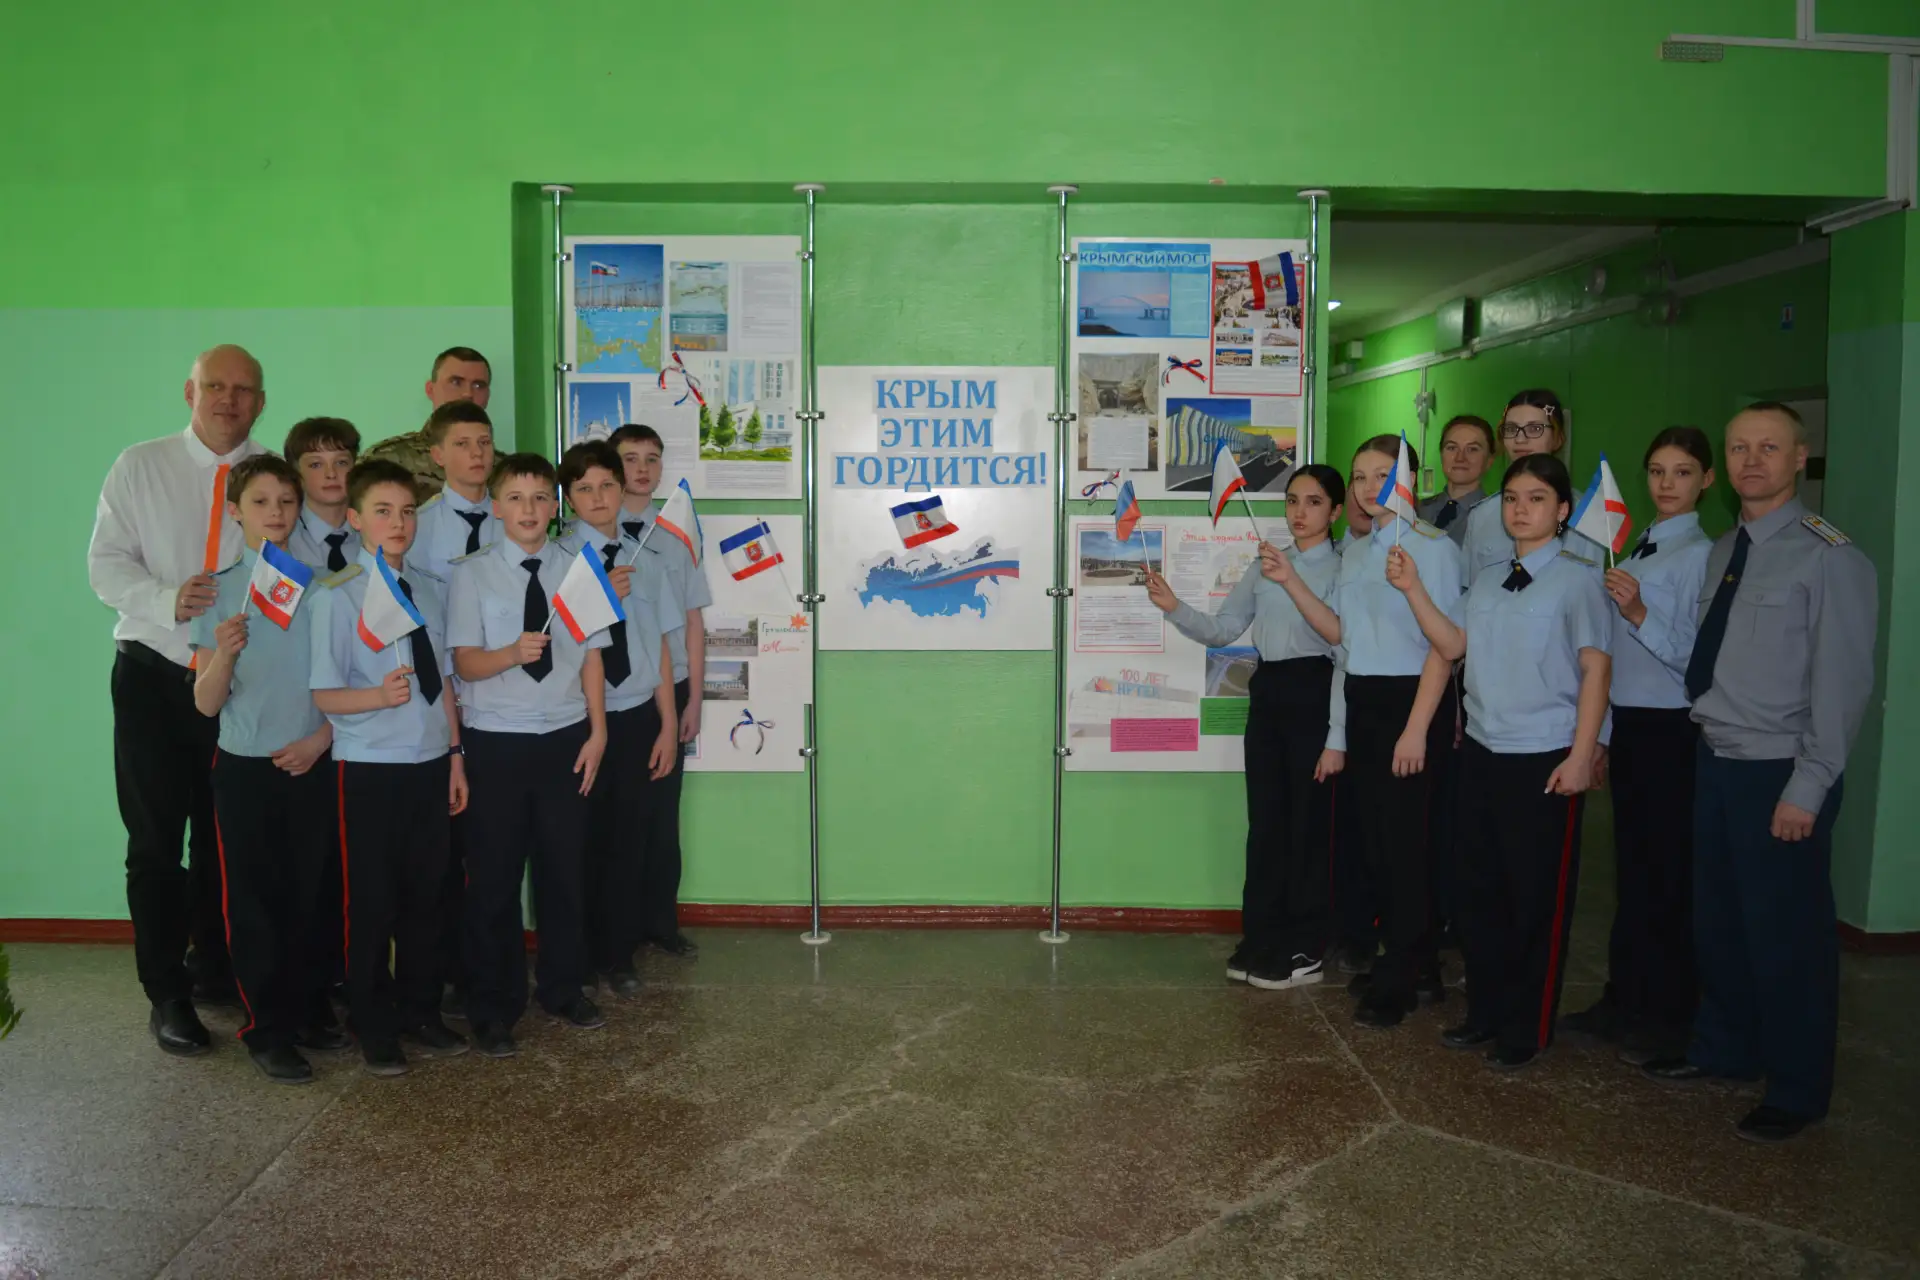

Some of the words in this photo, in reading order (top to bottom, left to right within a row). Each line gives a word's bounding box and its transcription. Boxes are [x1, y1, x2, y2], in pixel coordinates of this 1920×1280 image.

[1079, 252, 1166, 265] КРЫМСКИЙ
[1167, 253, 1208, 264] МОСТ
[876, 380, 997, 409] КРЫМ
[880, 418, 993, 447] ЭТИМ
[834, 452, 1046, 492] ГОРДИТСЯ!
[1120, 668, 1140, 682] 100
[1143, 672, 1170, 686] ЛЕТ
